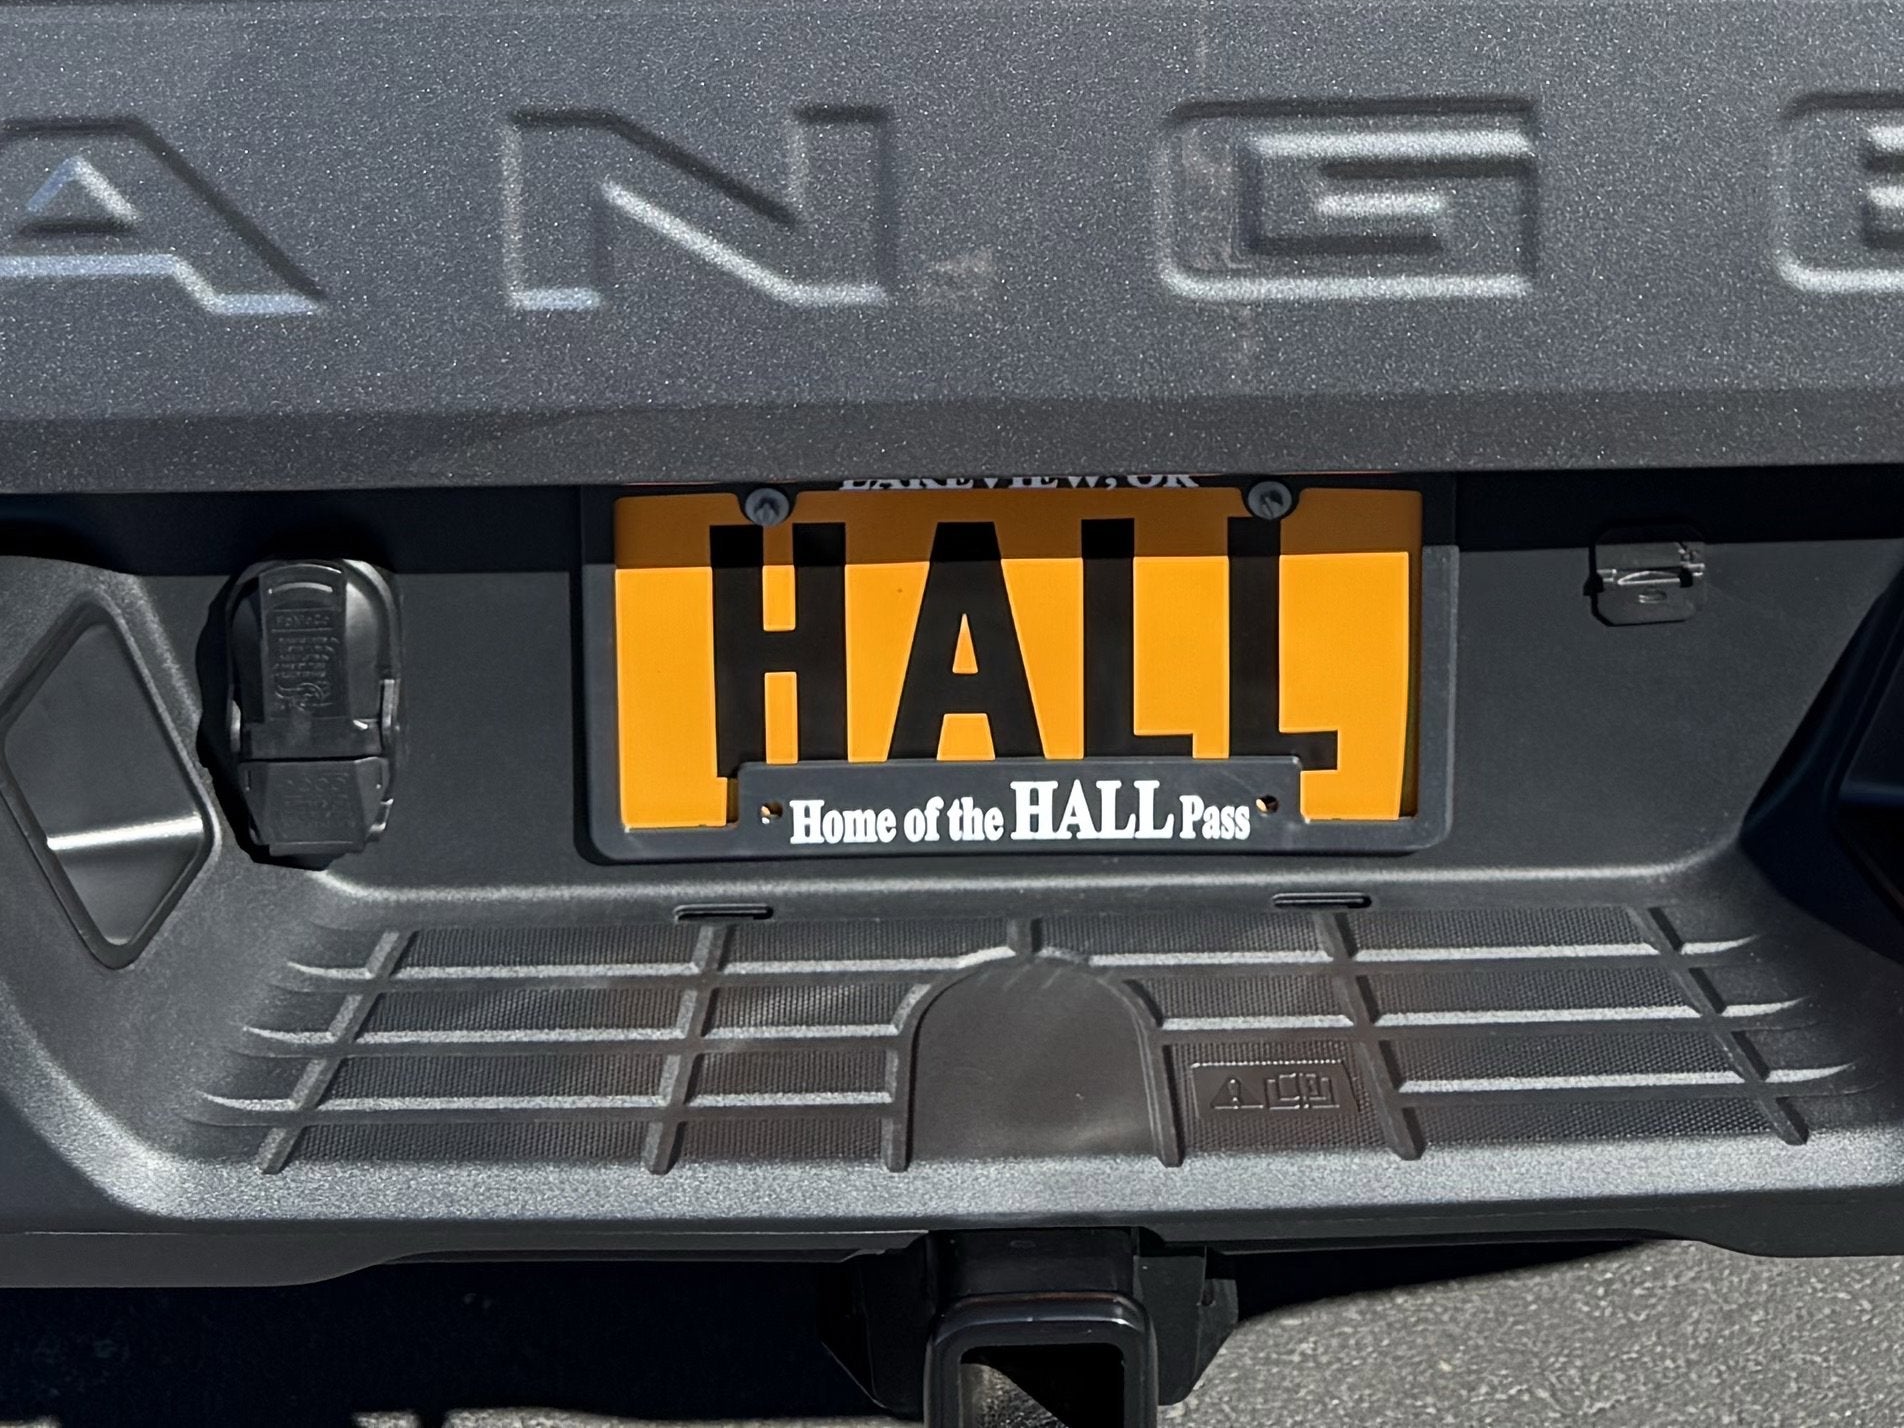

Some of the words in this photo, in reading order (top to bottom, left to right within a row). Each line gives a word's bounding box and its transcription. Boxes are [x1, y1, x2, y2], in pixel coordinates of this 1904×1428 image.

[709, 517, 1340, 778] HALL
[789, 799, 897, 844] Home
[904, 796, 944, 842] of
[948, 796, 1004, 841] the
[1010, 779, 1175, 840] HALL
[1179, 795, 1251, 839] Pass
